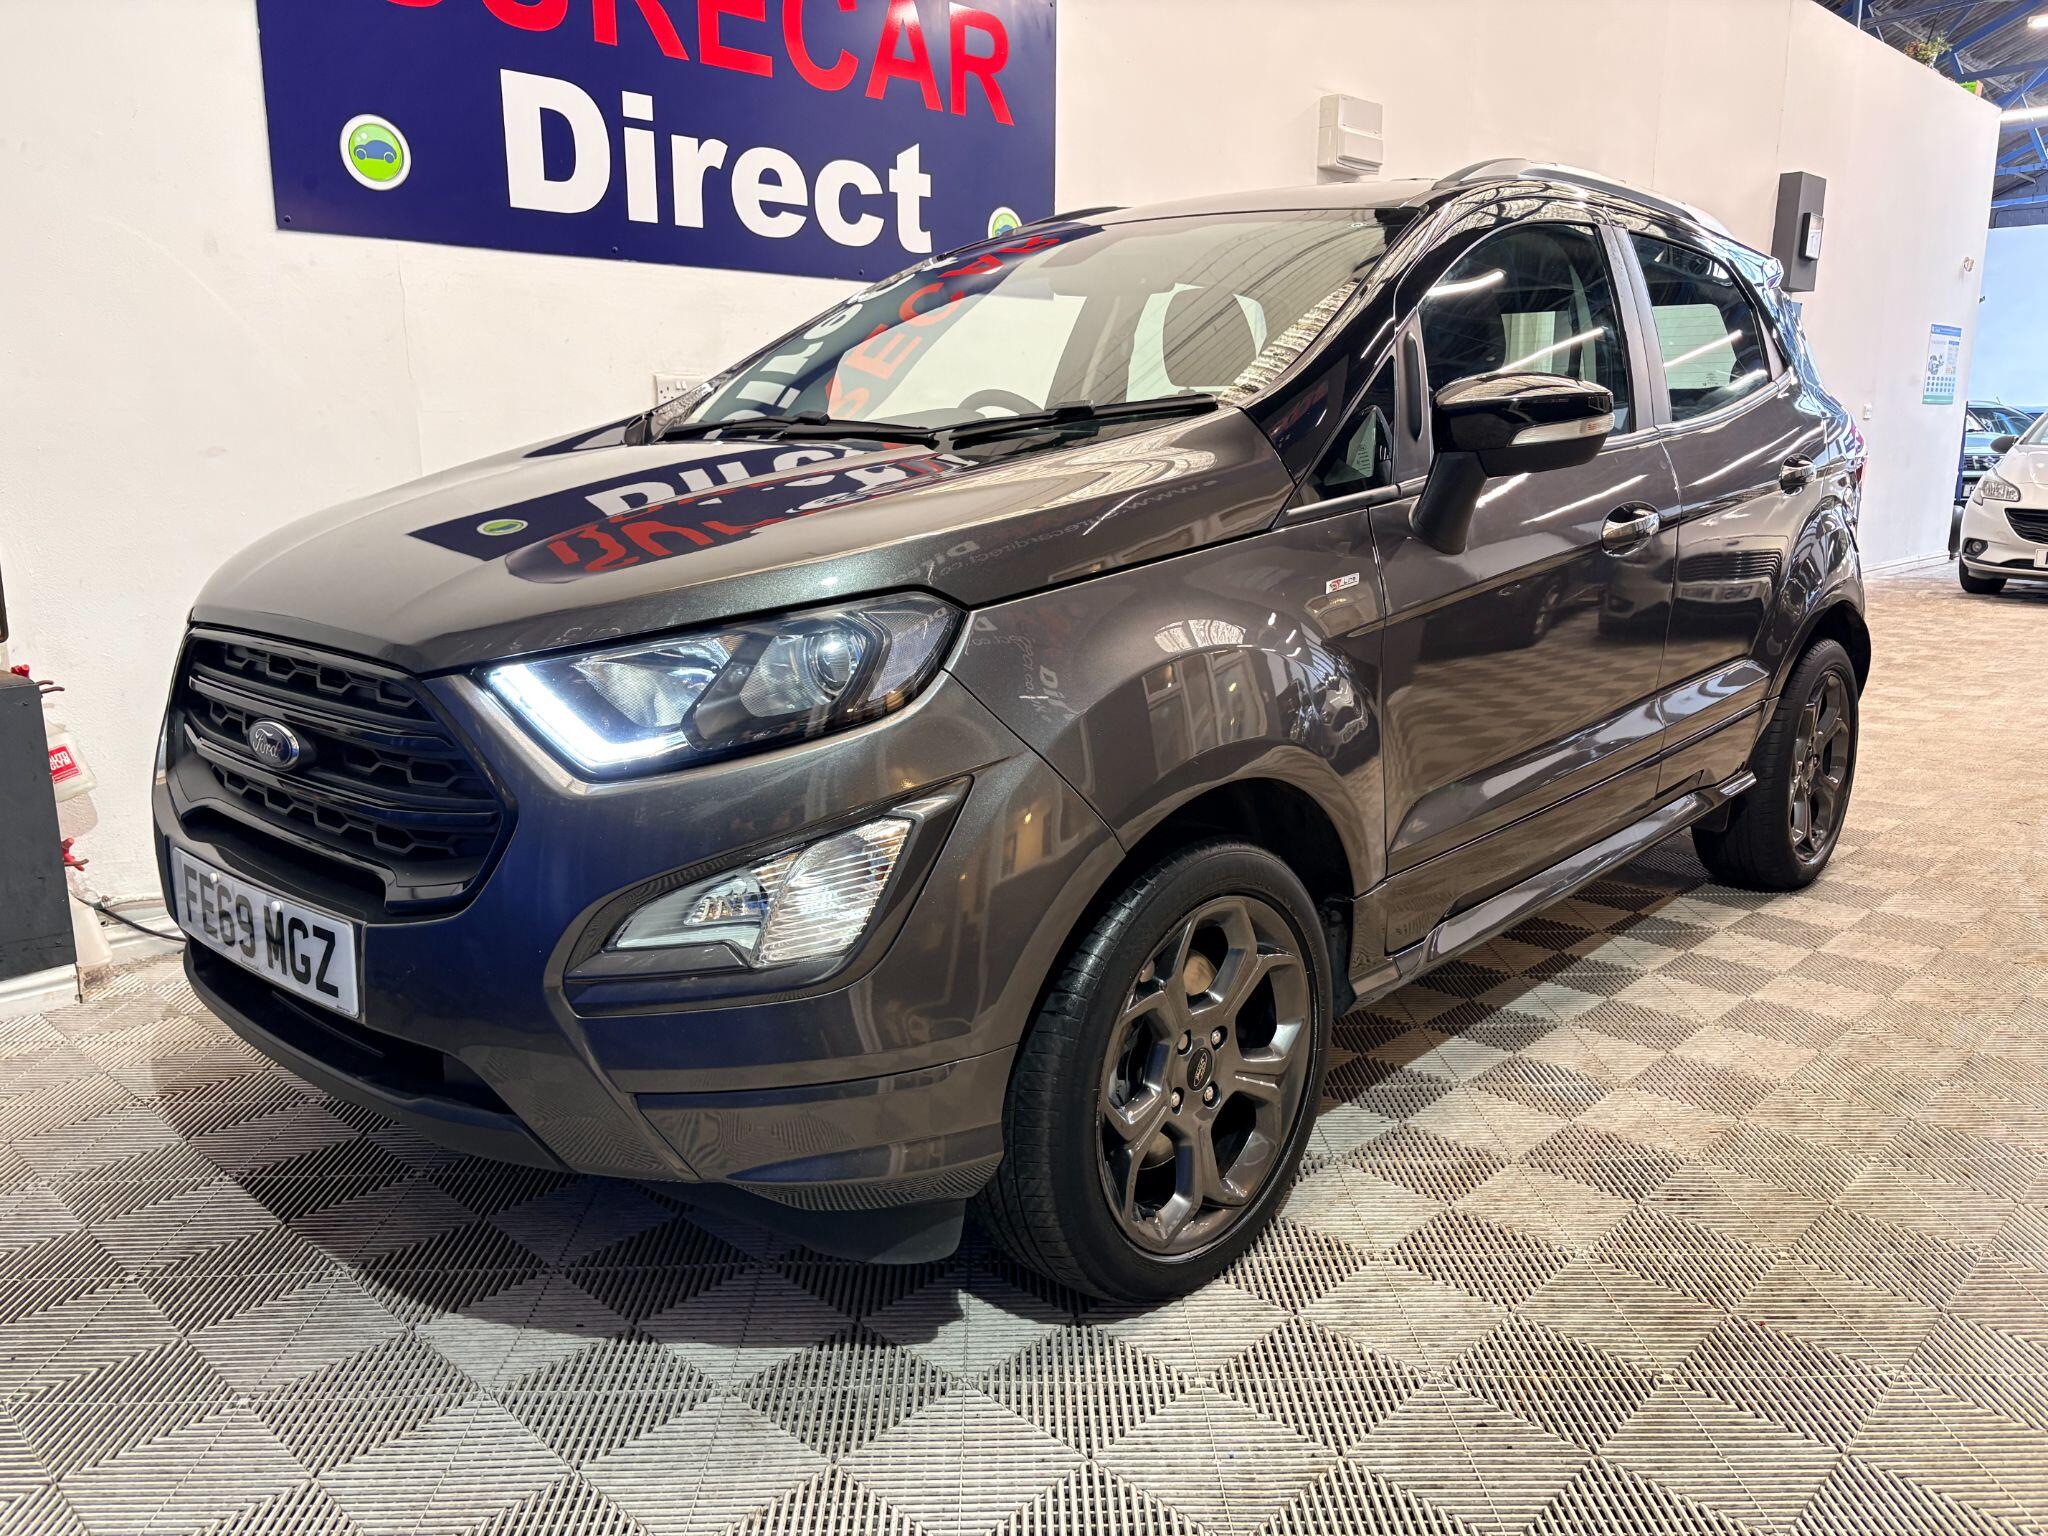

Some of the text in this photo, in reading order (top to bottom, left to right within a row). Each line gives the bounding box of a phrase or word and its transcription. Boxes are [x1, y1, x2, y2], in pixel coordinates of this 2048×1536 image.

[380, 0, 1015, 126] ECAR
[499, 68, 933, 254] Direct
[252, 729, 282, 758] Ford
[183, 863, 339, 999] FE69 MGZ
